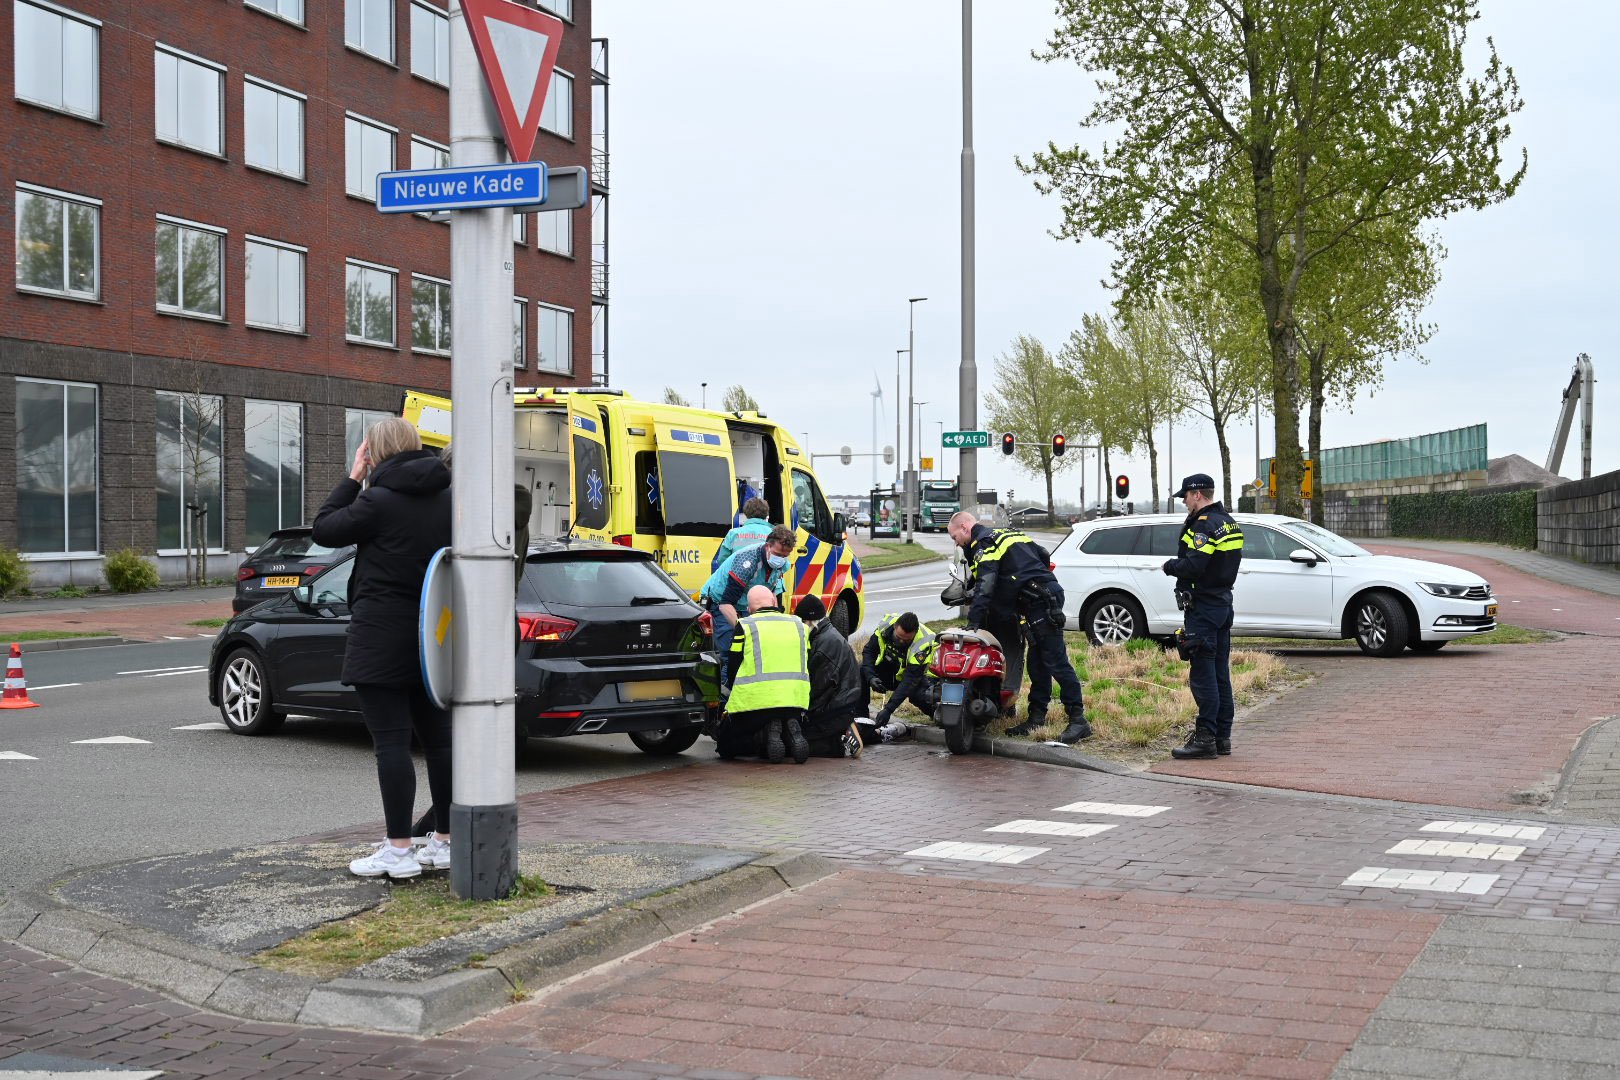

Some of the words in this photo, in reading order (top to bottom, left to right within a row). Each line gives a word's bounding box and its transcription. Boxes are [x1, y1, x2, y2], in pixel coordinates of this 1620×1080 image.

[394, 176, 468, 199] Nieuwe
[473, 173, 525, 194] Kade
[965, 434, 987, 444] AED
[266, 576, 297, 586] HH-144-F
